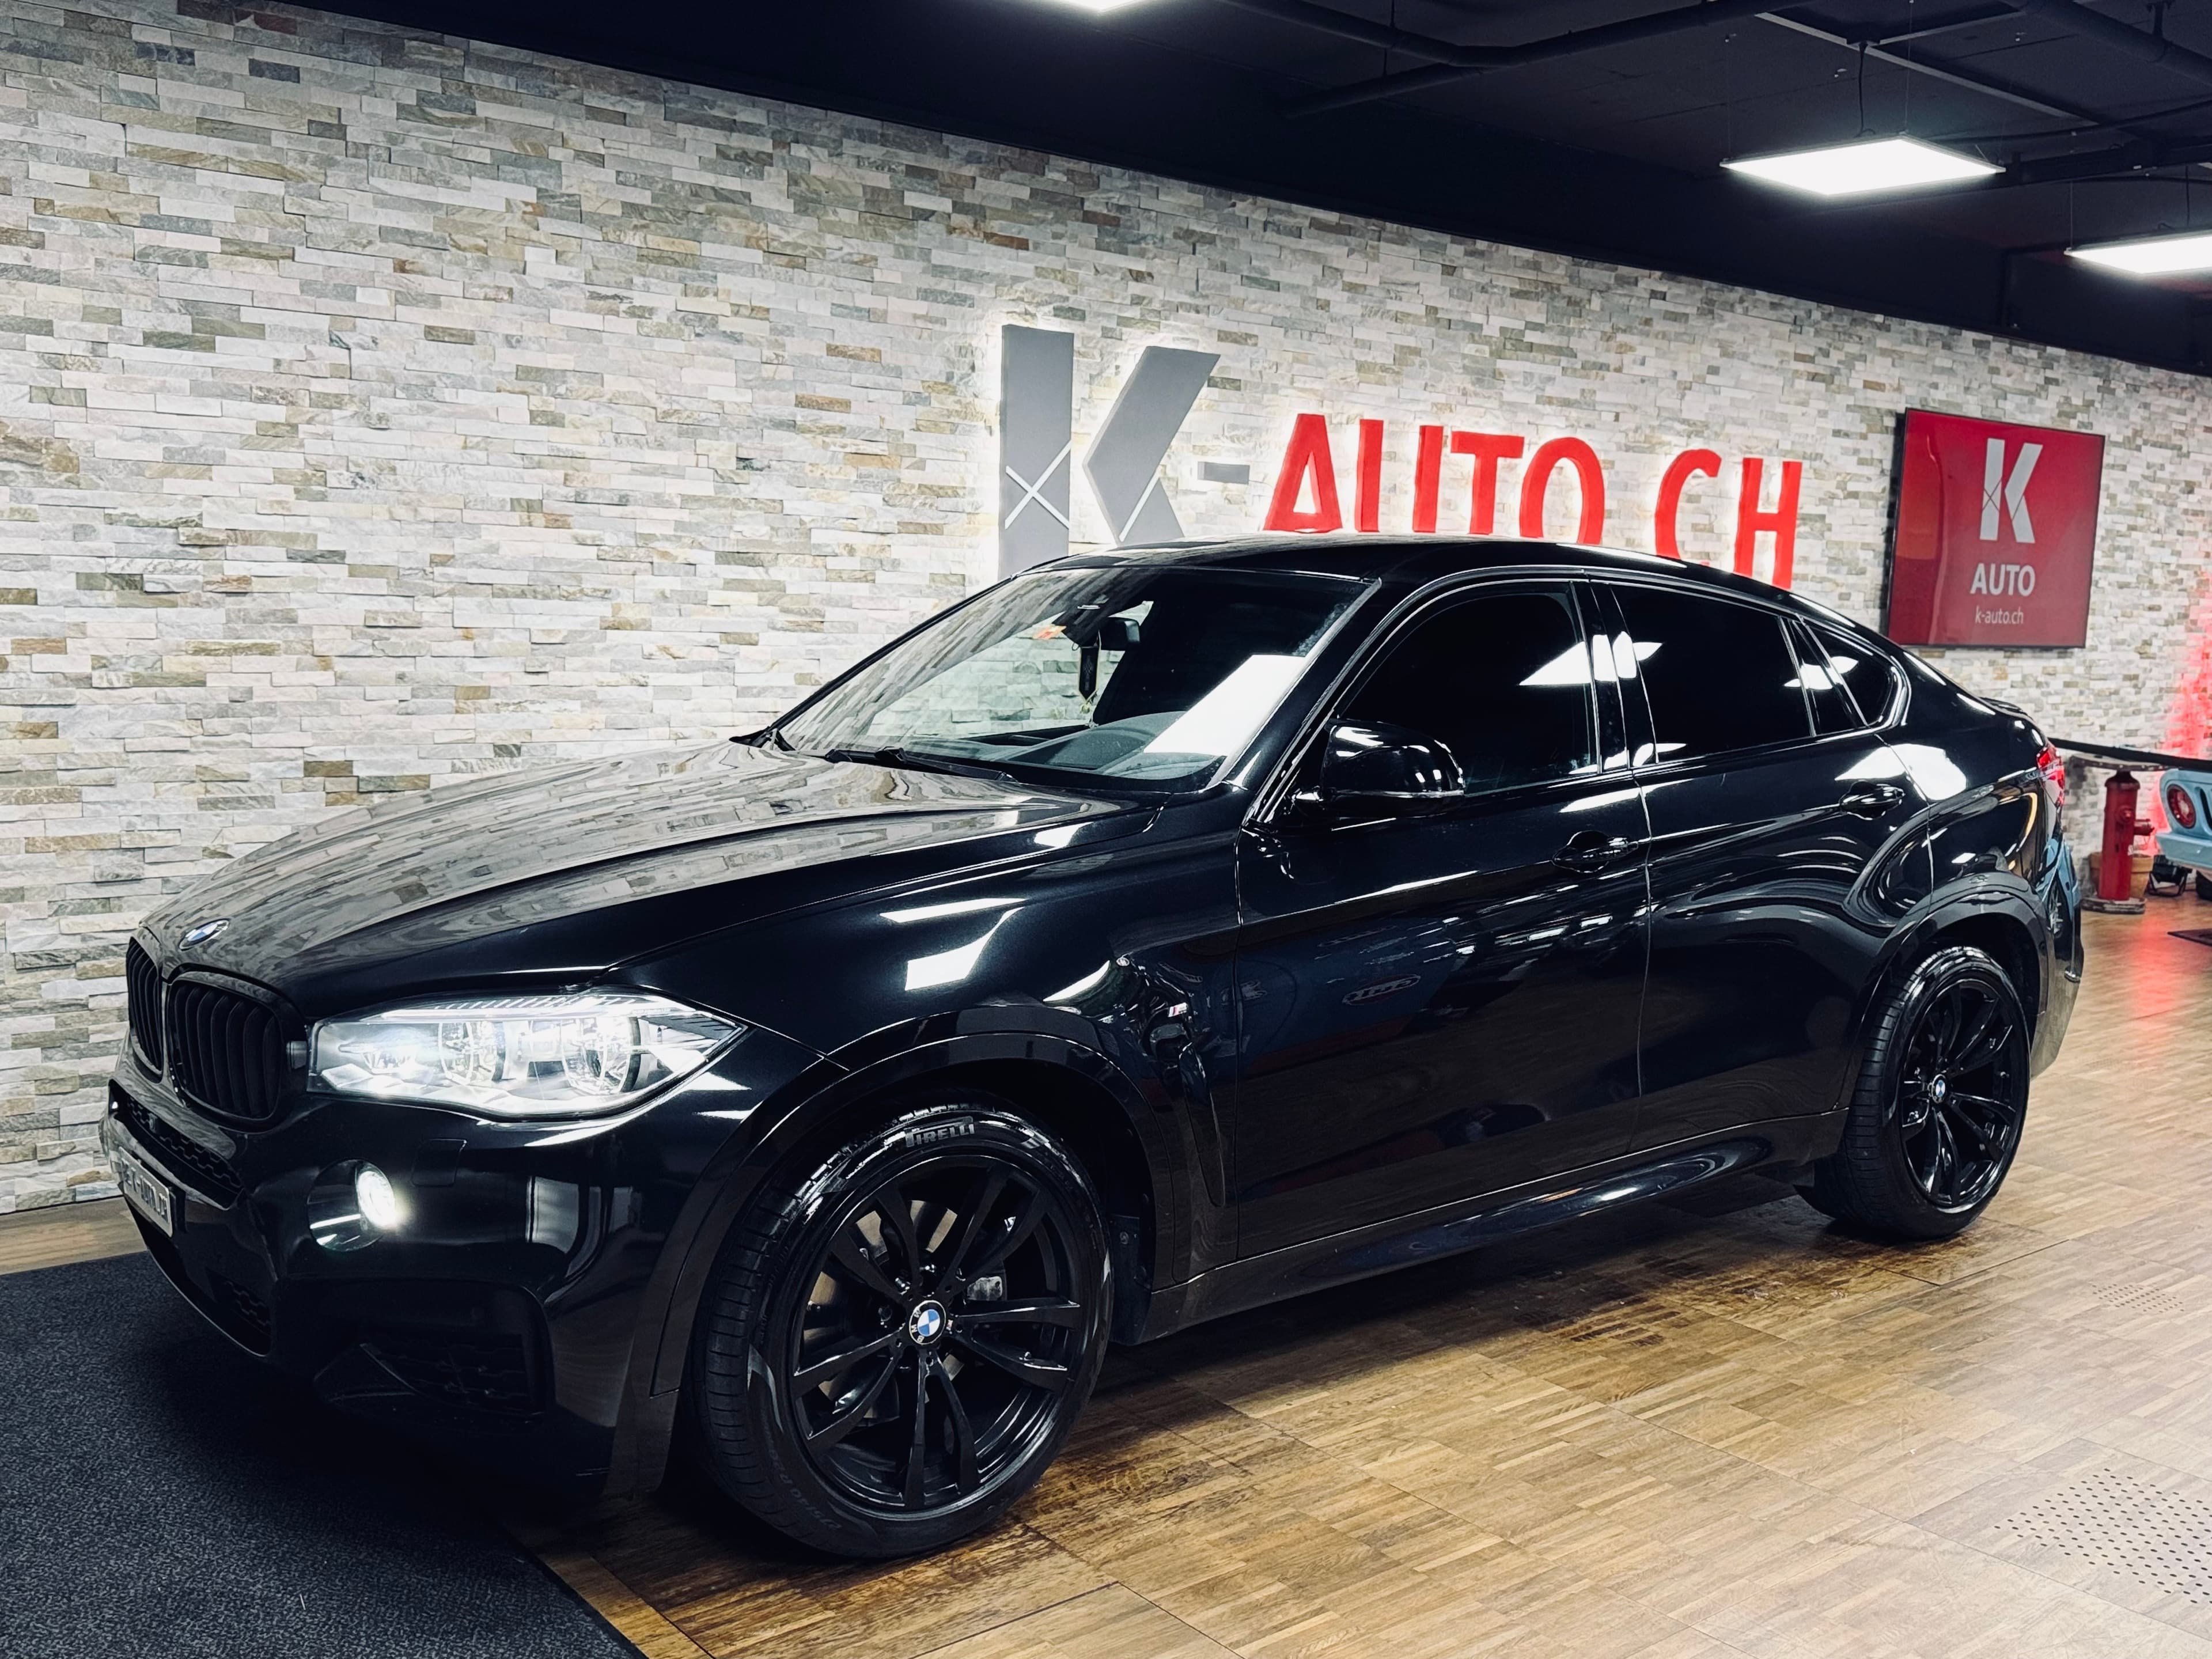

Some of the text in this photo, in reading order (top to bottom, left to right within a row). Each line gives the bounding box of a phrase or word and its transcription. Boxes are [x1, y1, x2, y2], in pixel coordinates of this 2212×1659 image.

[1980, 438, 2043, 544] K
[1970, 563, 2035, 597] AUTO
[1975, 605, 2024, 624] k-auto.ch
[904, 1116, 975, 1147] PIRELLI
